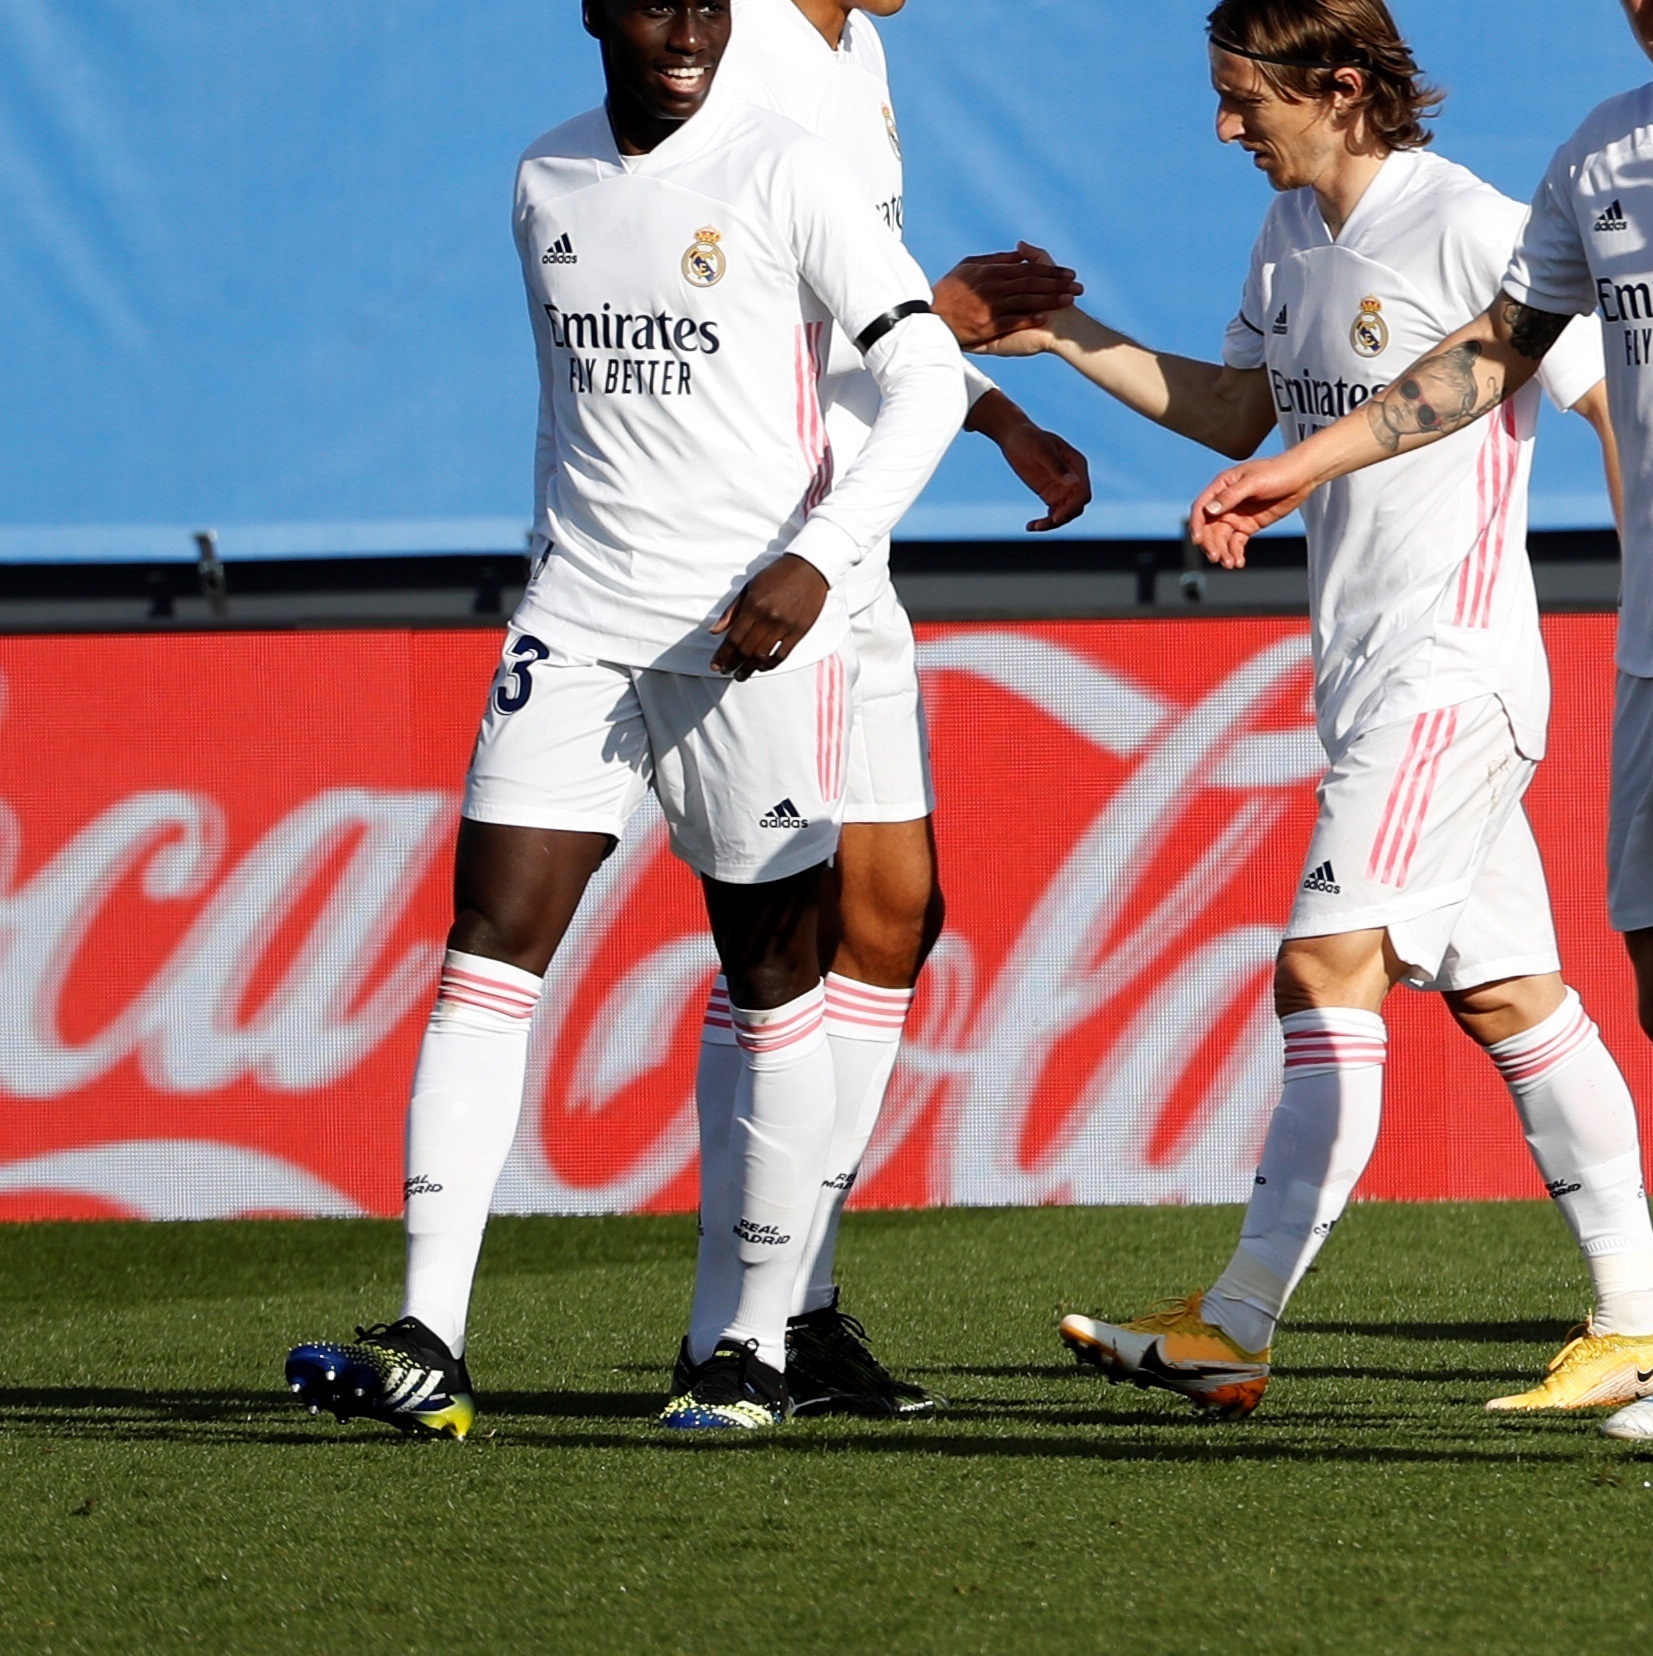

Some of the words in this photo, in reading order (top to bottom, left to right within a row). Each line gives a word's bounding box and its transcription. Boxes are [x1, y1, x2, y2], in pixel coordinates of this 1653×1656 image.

[542, 251, 578, 265] adidas
[544, 302, 720, 355] Emirates
[1624, 328, 1652, 366] FLY
[569, 358, 596, 394] FLY
[605, 358, 692, 395] BETTER
[759, 816, 809, 829] adidas
[1303, 878, 1341, 895] adidas
[733, 1224, 791, 1246] MADRID
[738, 1217, 780, 1236] REAL
